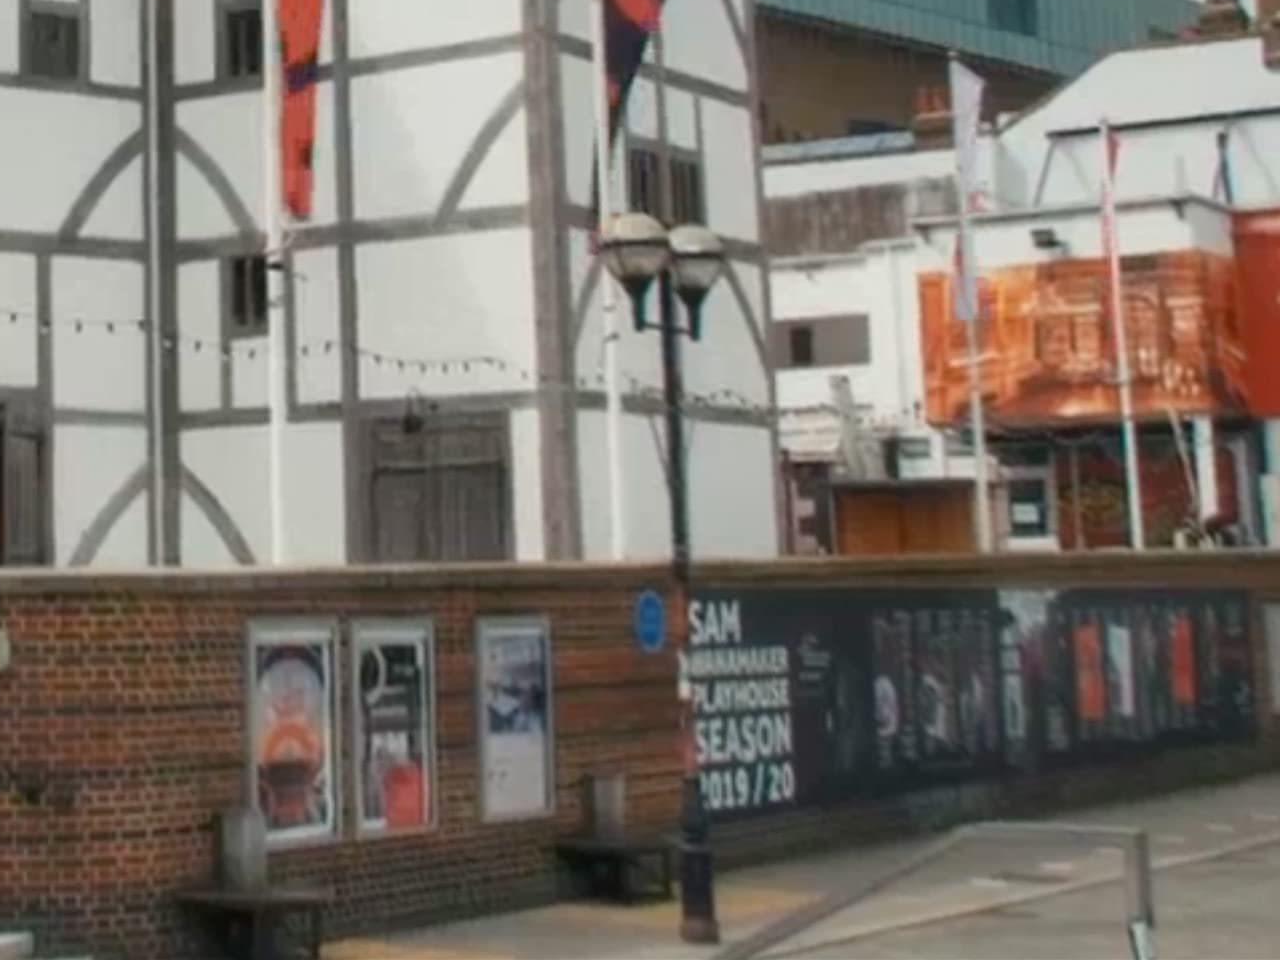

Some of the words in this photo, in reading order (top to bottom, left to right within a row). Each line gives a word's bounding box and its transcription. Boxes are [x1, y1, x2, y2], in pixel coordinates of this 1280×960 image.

[688, 600, 742, 645] SAM
[692, 676, 790, 714] PLAYHOUSE
[695, 712, 793, 766] SEASON
